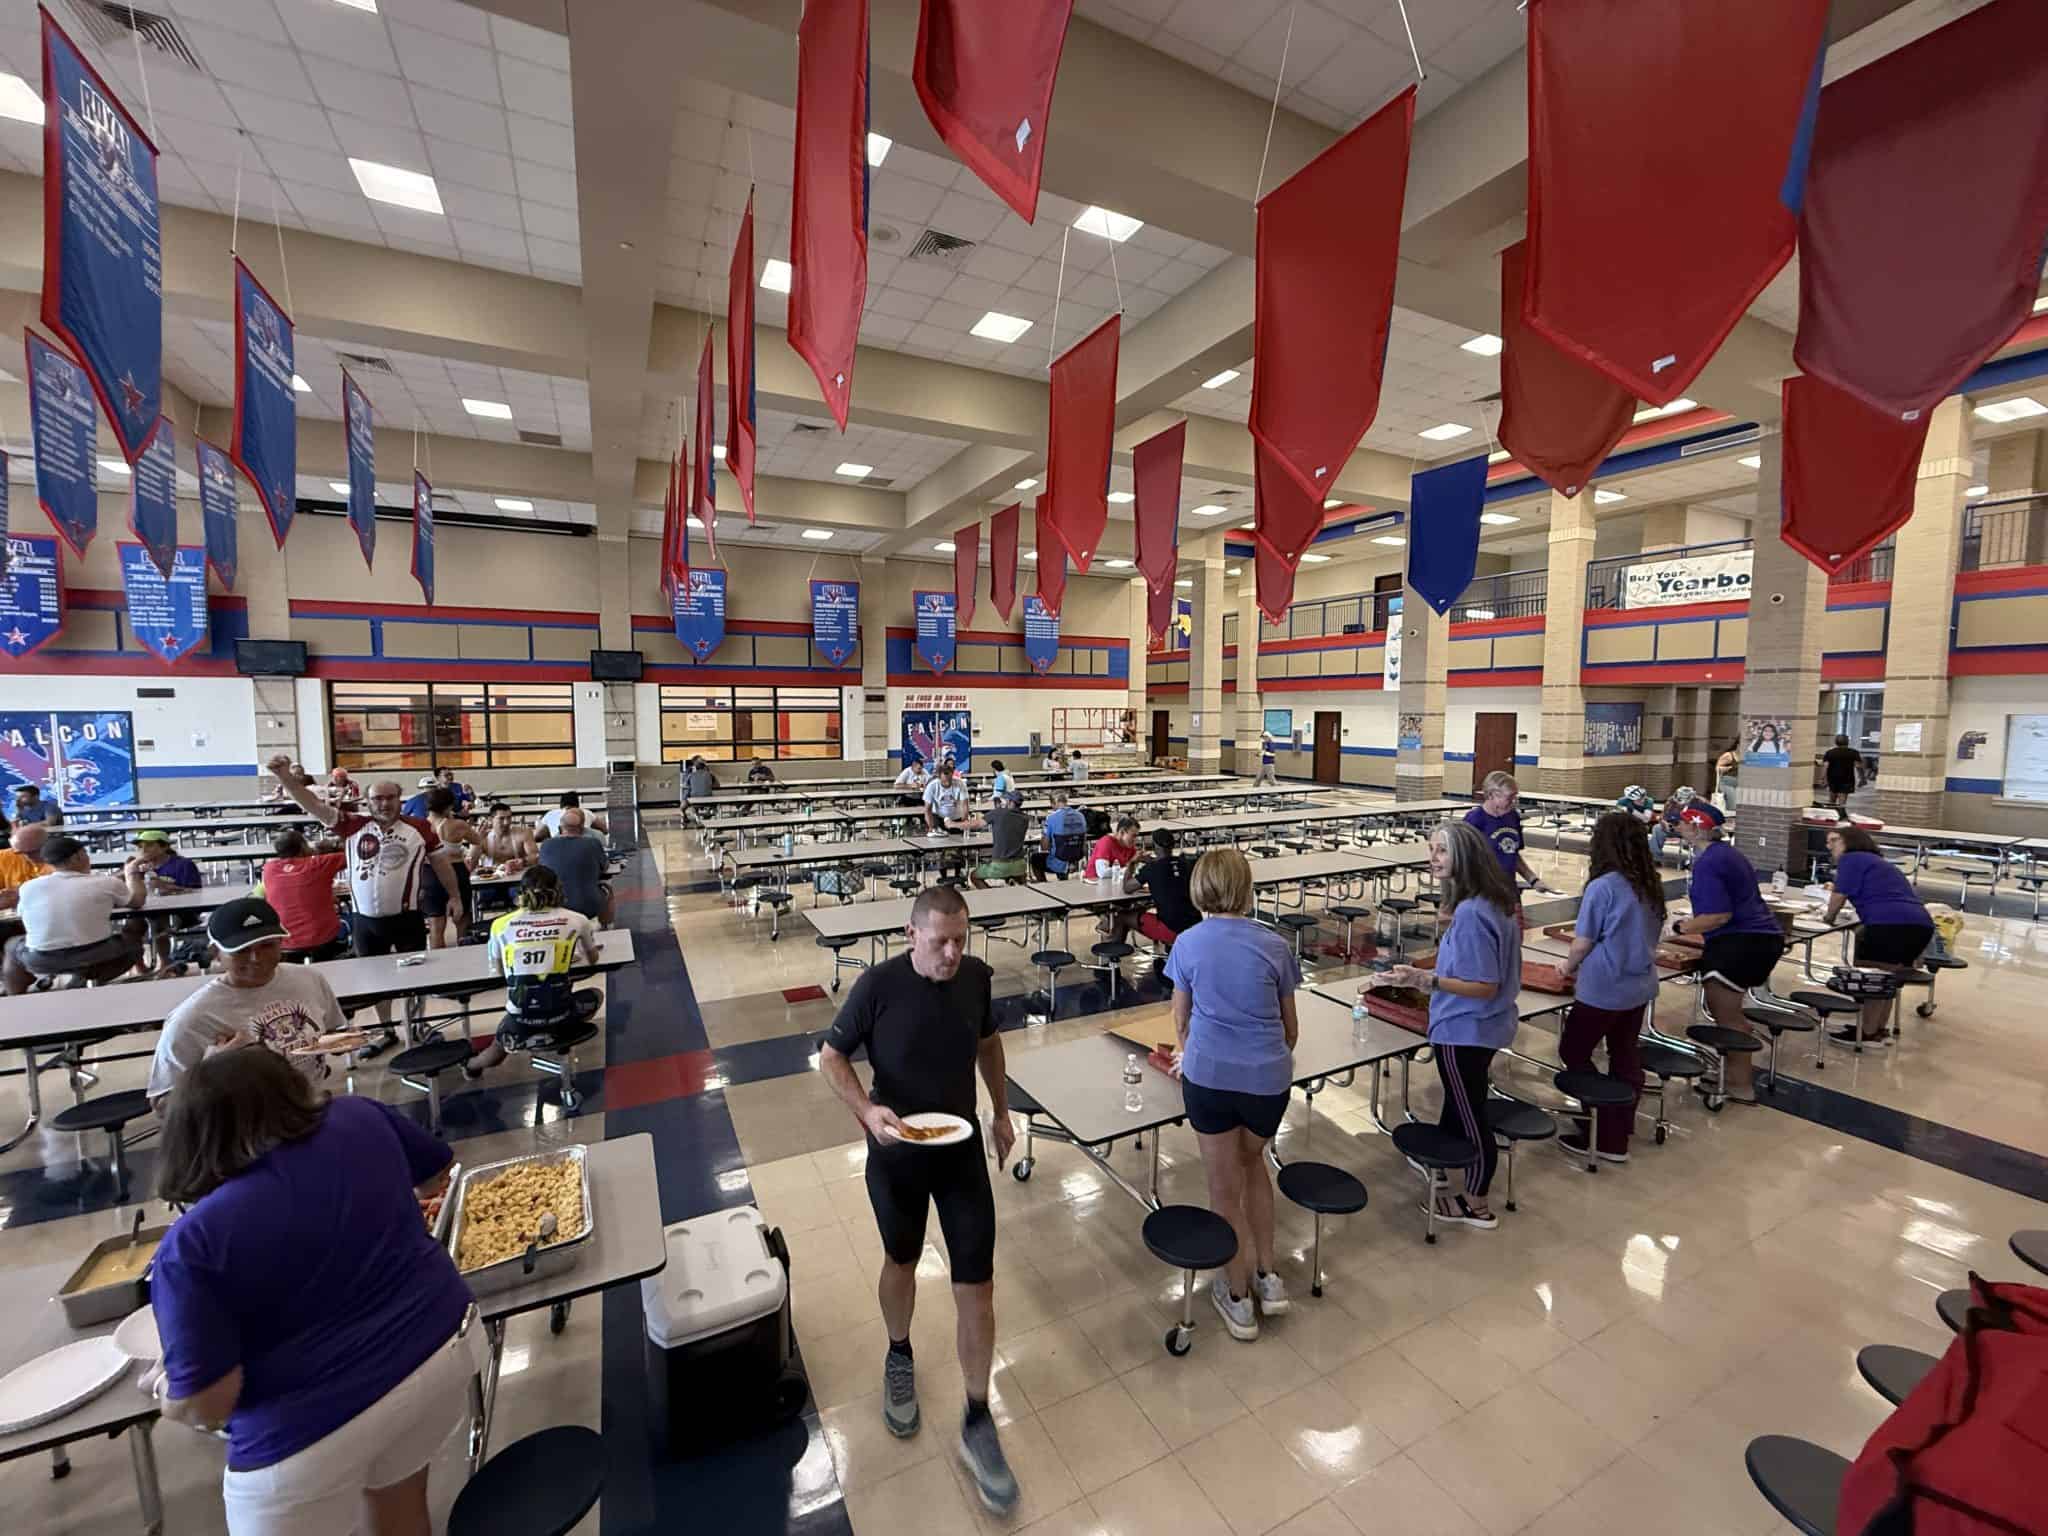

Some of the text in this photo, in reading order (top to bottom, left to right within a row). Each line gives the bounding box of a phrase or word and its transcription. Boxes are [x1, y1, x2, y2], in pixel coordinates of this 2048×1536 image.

[1629, 570, 1686, 583] Buy Your
[1657, 573, 1751, 593] Yearbo
[10, 721, 123, 747] ALCON
[907, 717, 968, 736] FALCON
[516, 928, 560, 938] Circus
[522, 951, 546, 965] 317
